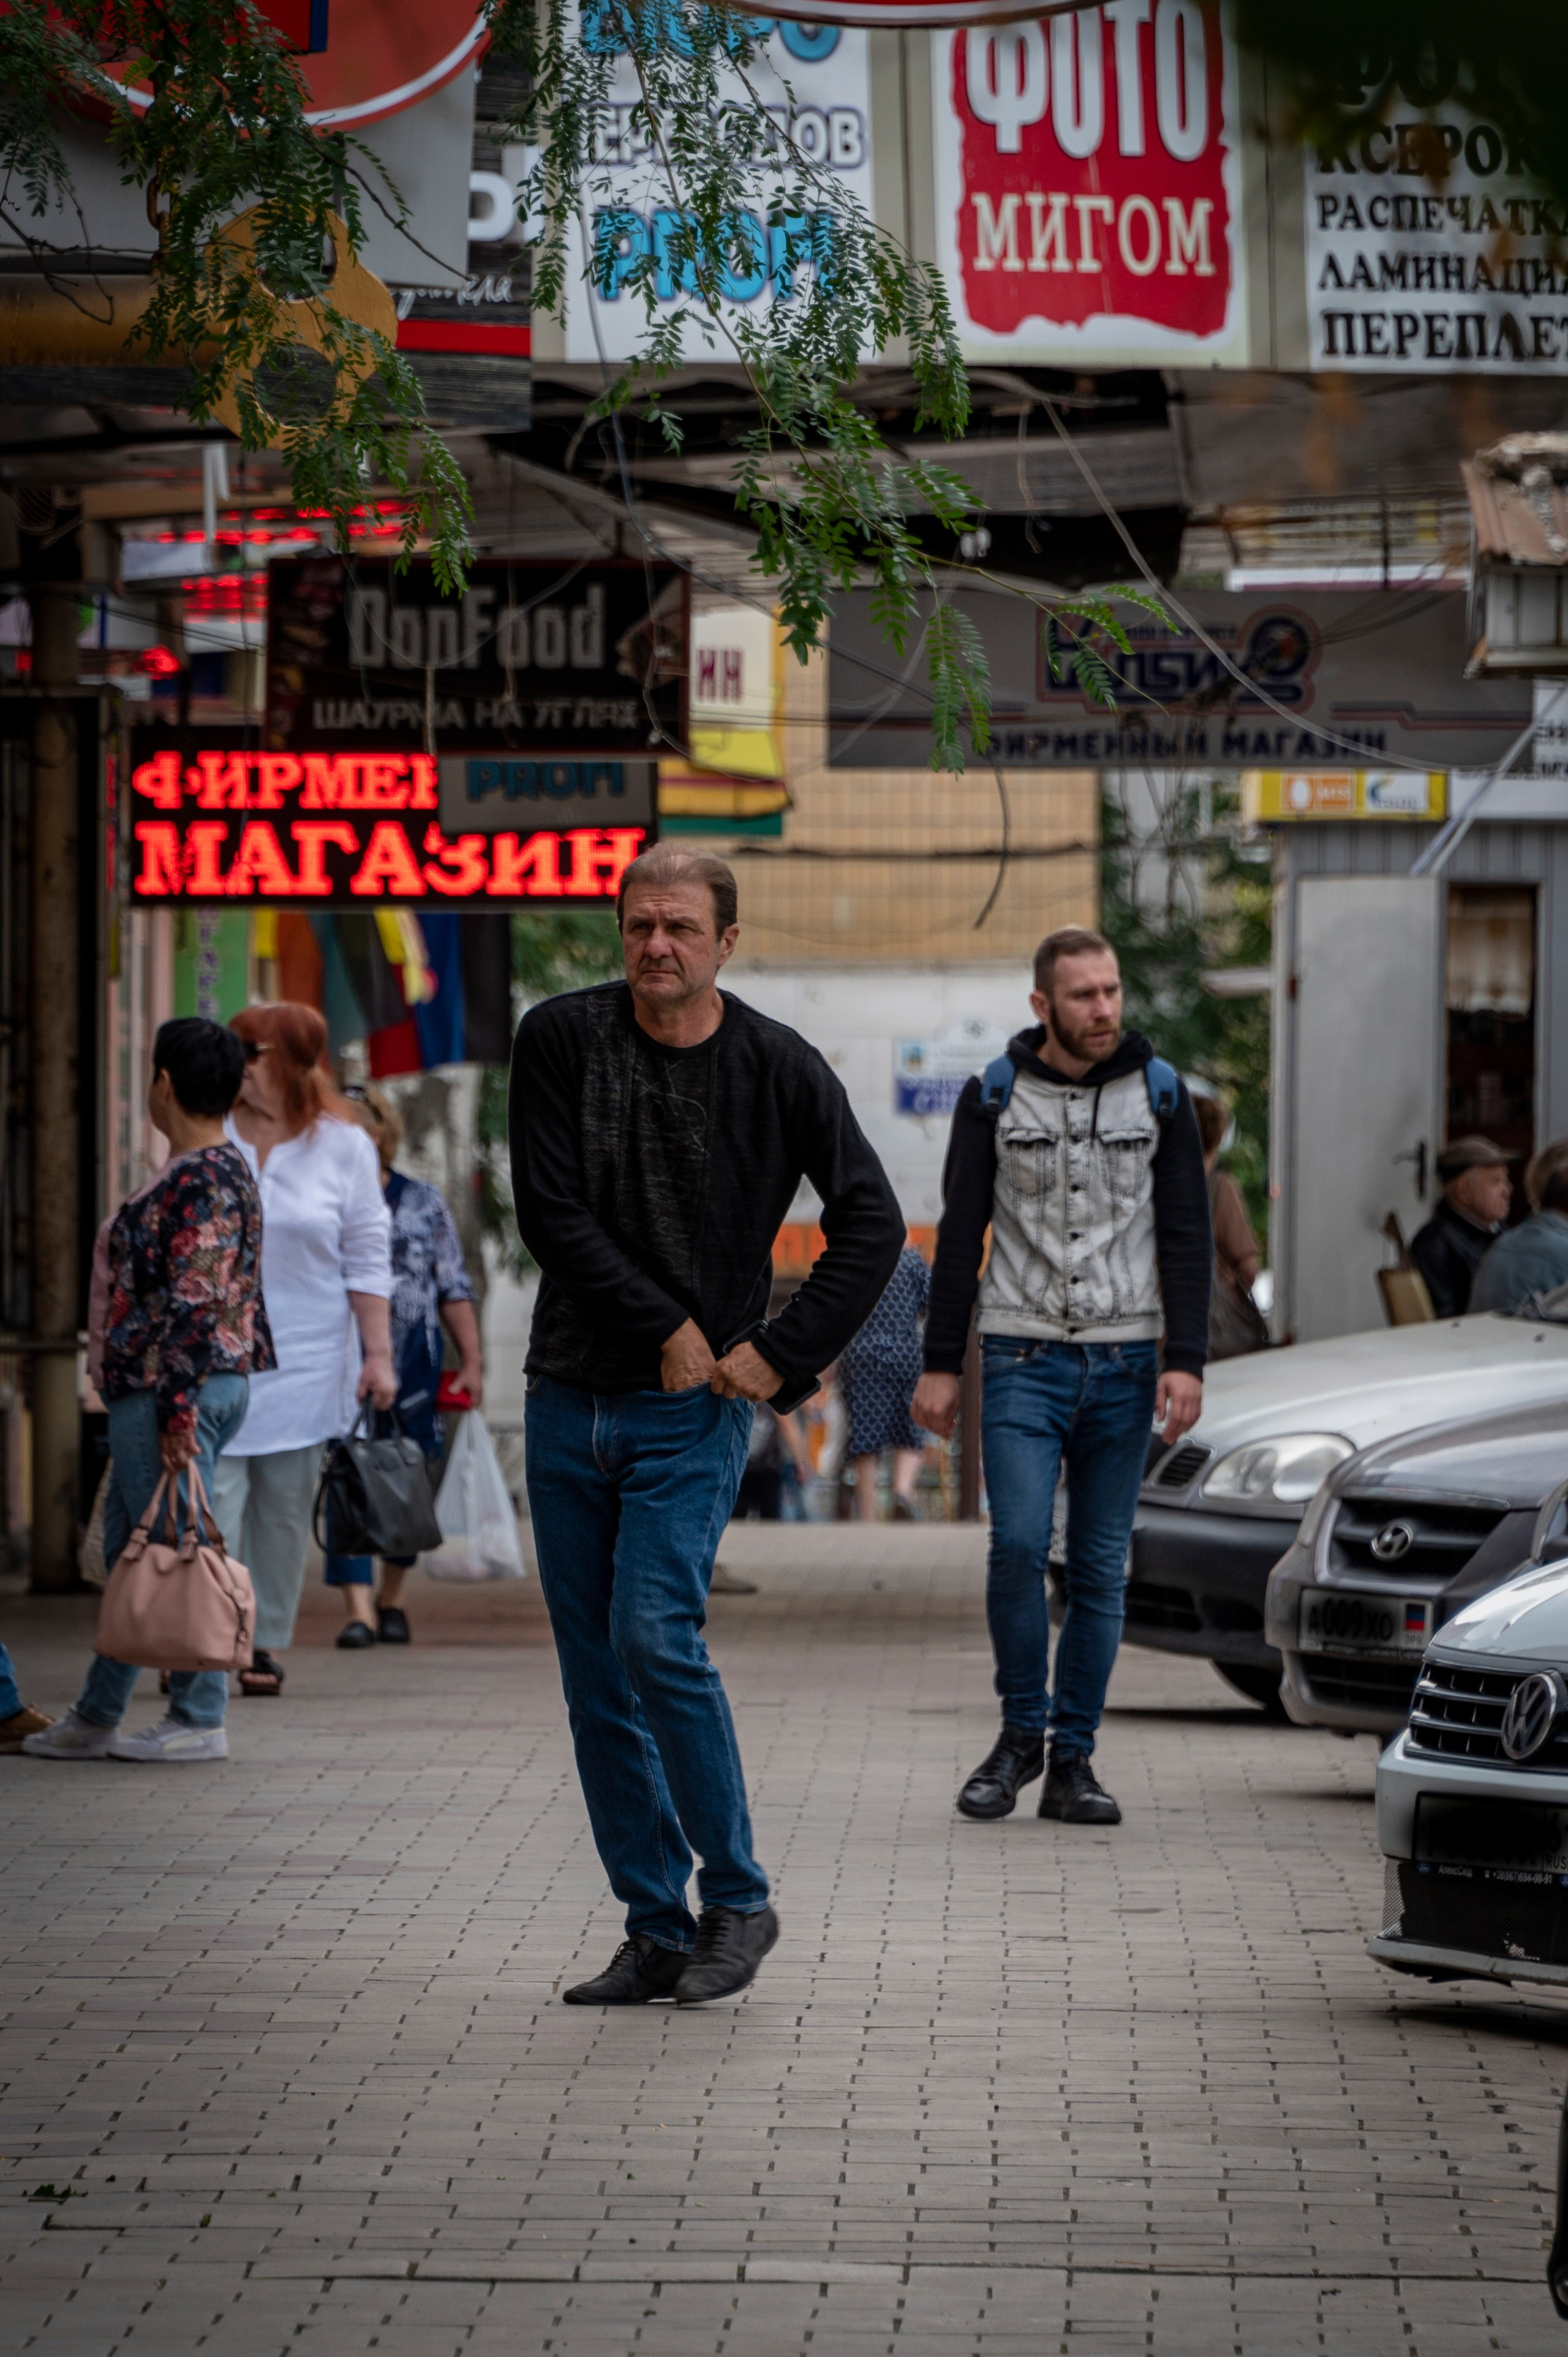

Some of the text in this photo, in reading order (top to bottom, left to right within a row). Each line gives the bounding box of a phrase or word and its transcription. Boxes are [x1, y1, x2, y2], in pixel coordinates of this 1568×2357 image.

[966, 0, 1209, 161] ФОТО
[971, 192, 1216, 276] МИГОМ
[1317, 194, 1568, 236] РАСПЕЧАТК
[1319, 252, 1568, 299] ЛАМИНАЦИ
[349, 581, 606, 670] DonFood
[312, 698, 467, 730] ШАУРМА
[475, 699, 527, 730] НА
[1223, 729, 1387, 760] МАГАЗИН
[468, 761, 624, 801] PROFI
[134, 820, 646, 896] МАГАЗИН
